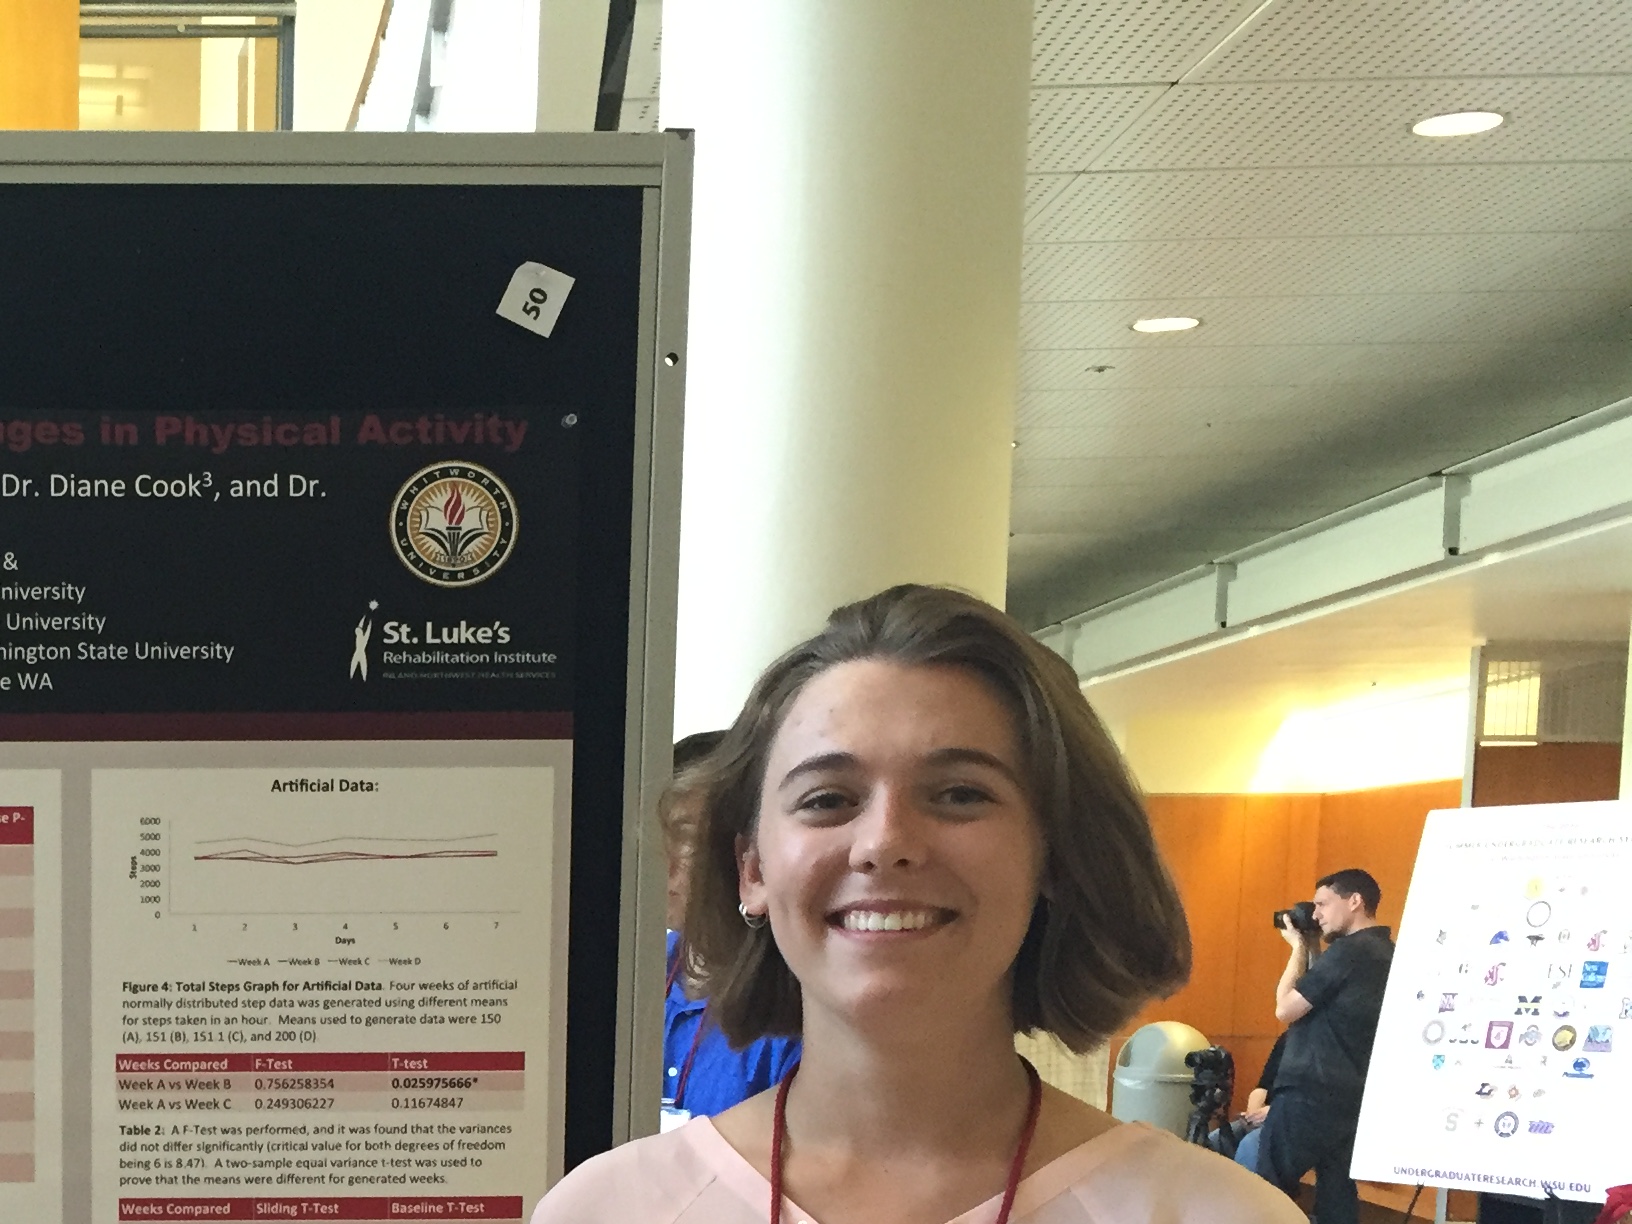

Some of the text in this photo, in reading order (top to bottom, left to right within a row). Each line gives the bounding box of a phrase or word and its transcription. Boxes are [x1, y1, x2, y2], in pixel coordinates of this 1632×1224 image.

[522, 288, 548, 321] 50
[99, 419, 138, 444] in
[154, 415, 340, 452] Physical
[357, 413, 526, 450] Activity
[2, 473, 39, 496] Dr.
[50, 473, 125, 497] Diane
[230, 473, 278, 497] and
[289, 474, 325, 496] Dr.
[400, 468, 507, 510] WHITWORTH
[3, 551, 18, 570] &
[400, 537, 508, 580] UNIVERSITY
[6, 612, 106, 634] University
[383, 620, 510, 644] St. Luke's
[77, 641, 128, 659] State
[135, 641, 234, 663] University
[383, 650, 556, 663] Rehabilitation Institute
[17, 672, 52, 690] WA
[270, 778, 378, 792] Artificial Data:
[122, 981, 158, 994] Figure
[160, 981, 172, 991] 4:
[175, 981, 205, 992] Total
[208, 981, 240, 994] Steps
[243, 980, 279, 993] Graph
[282, 980, 299, 991] for
[302, 980, 351, 991] Artificial
[118, 1058, 228, 1070] Weeks Compared
[255, 1058, 292, 1069] F-Test
[391, 1057, 427, 1068] T-test
